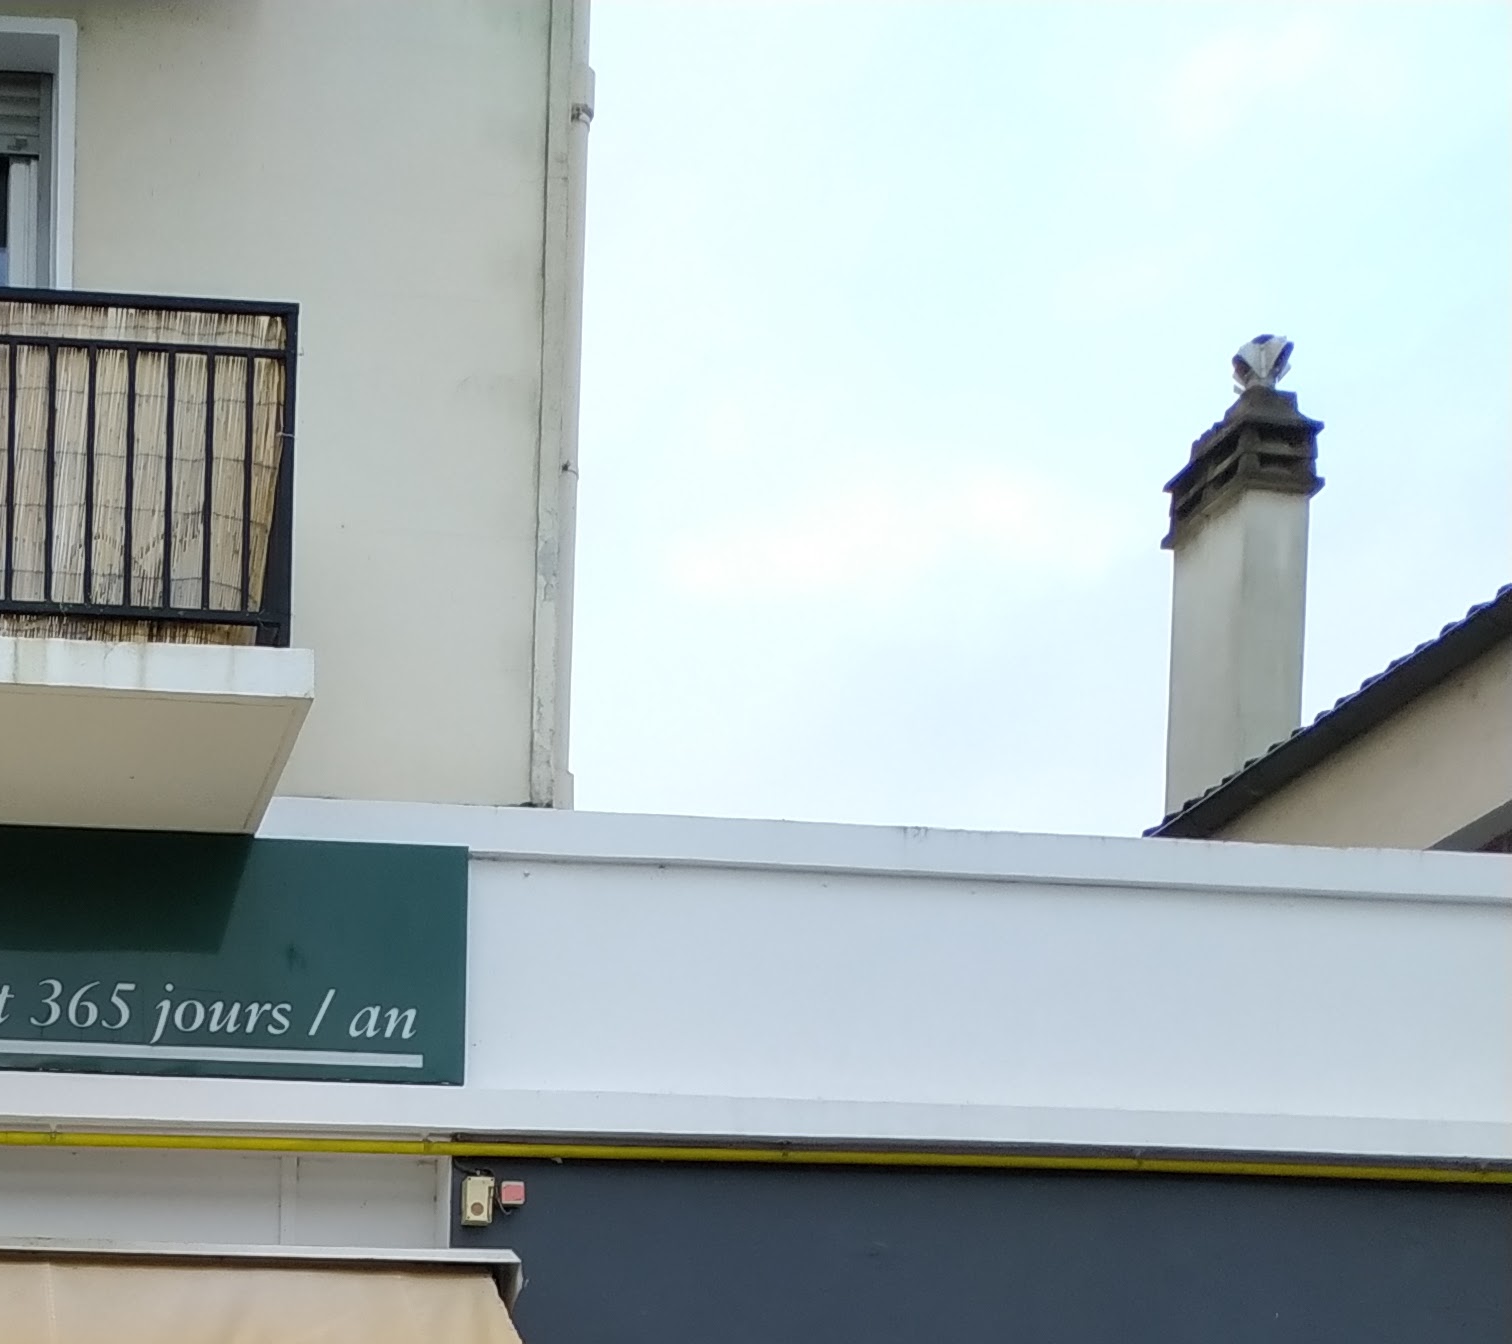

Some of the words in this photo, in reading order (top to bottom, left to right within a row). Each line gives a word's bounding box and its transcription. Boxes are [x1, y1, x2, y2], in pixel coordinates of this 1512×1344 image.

[29, 978, 137, 1031] 365
[150, 983, 293, 1045] jours
[307, 988, 337, 1037] /
[348, 1003, 419, 1040] an
